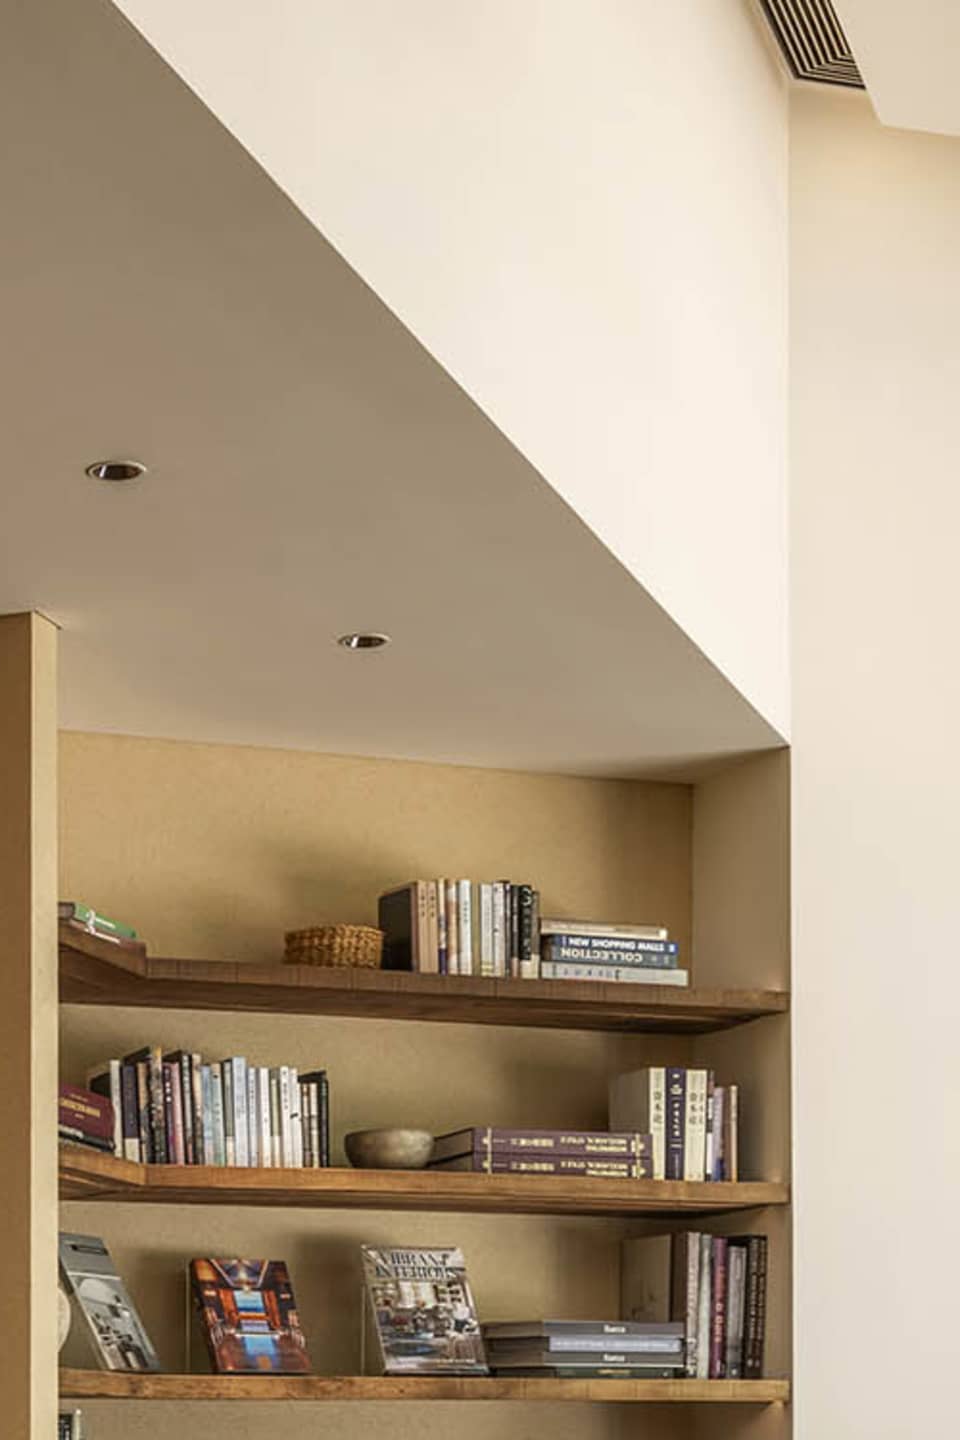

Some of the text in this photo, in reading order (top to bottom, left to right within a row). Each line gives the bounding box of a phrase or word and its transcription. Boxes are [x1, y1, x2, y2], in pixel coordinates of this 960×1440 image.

[568, 938, 589, 947] NEW
[591, 939, 636, 951] SHOPPING
[638, 942, 665, 952] MALLS
[559, 948, 644, 963] COLLECTION
